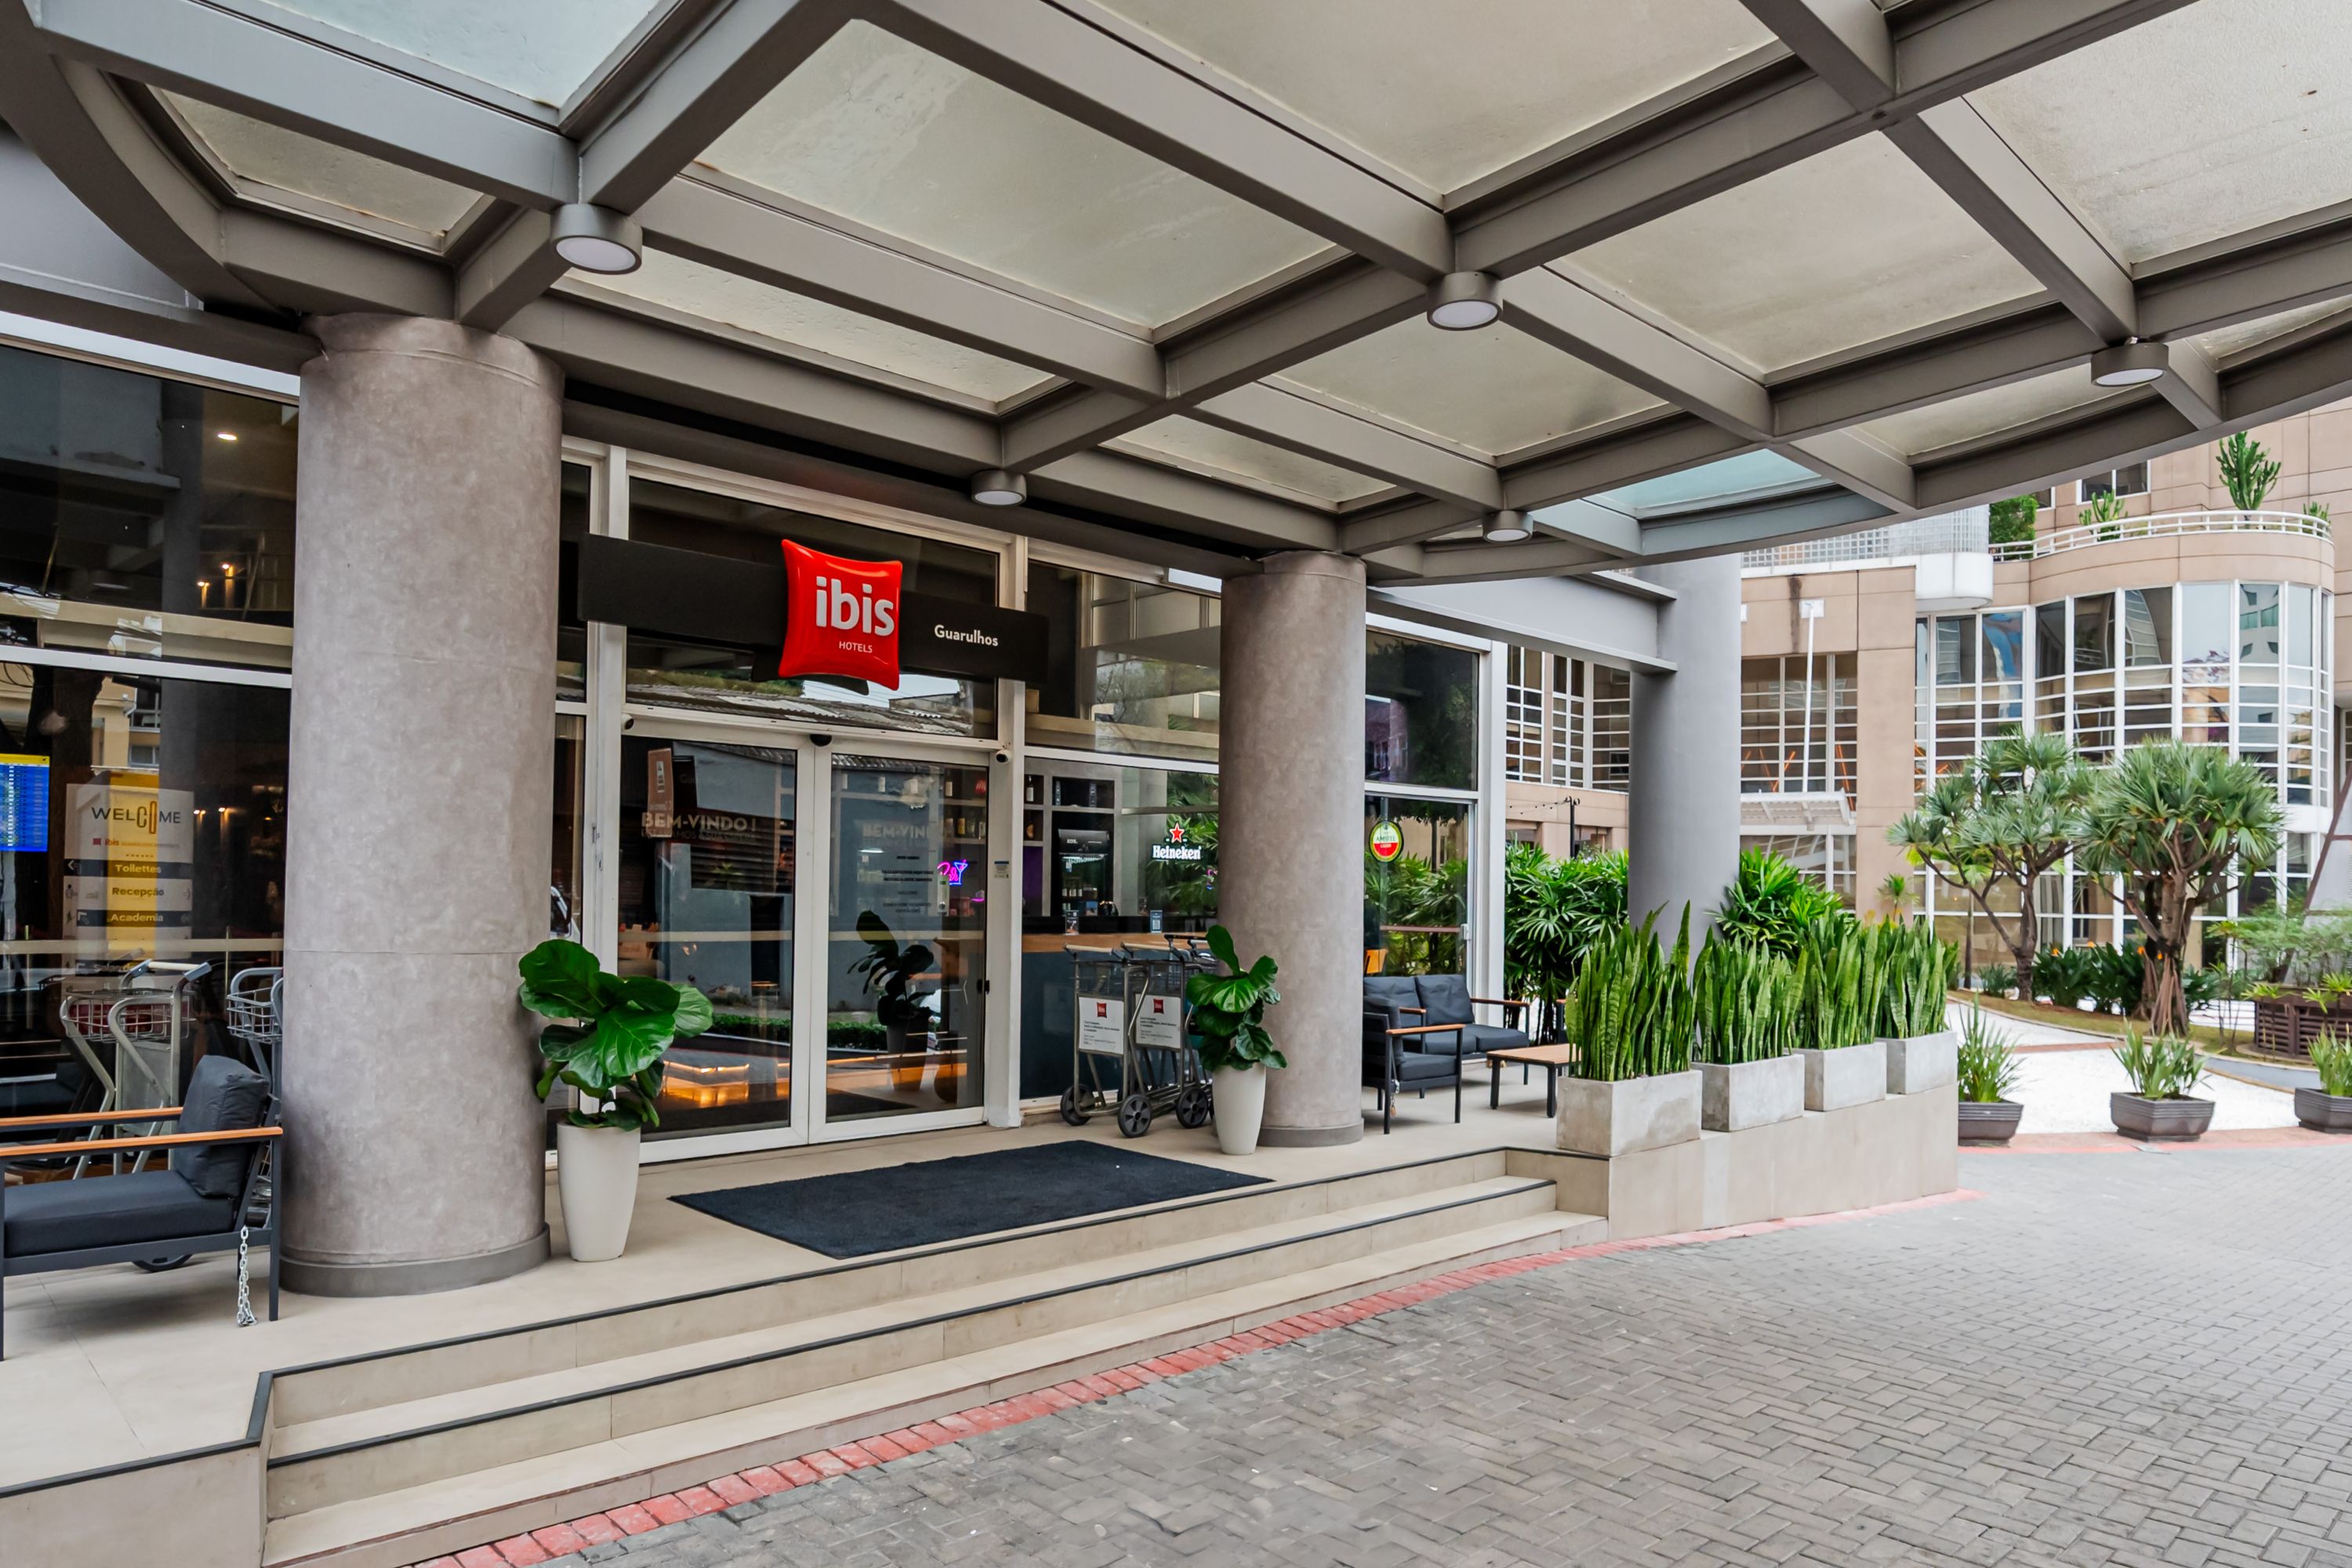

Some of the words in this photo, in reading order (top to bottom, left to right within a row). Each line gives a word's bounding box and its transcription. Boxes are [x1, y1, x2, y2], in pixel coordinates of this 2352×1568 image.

[816, 575, 895, 637] ibis
[934, 624, 999, 647] Guarulhos
[839, 641, 873, 654] HOTELS
[91, 800, 181, 834] WELCOME
[1152, 844, 1201, 859] Heineken
[115, 864, 162, 873] Toilettes
[112, 887, 165, 897] Recepção
[111, 913, 164, 922] Academia
